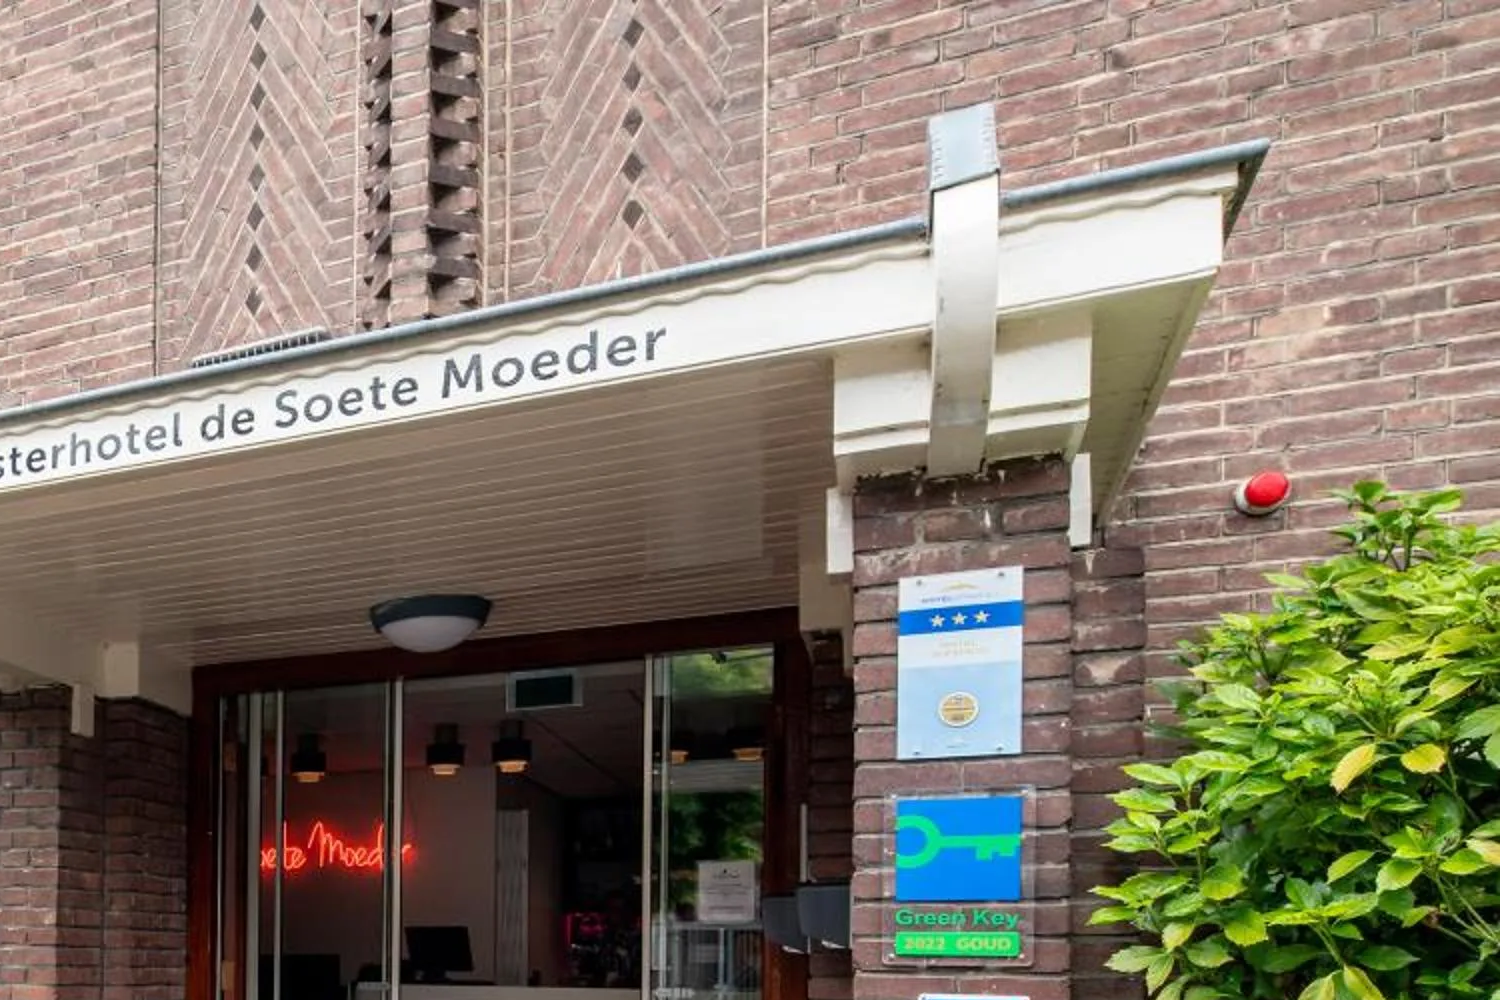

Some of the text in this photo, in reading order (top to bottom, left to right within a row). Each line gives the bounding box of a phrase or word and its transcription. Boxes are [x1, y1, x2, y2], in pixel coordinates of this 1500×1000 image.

[199, 403, 256, 441] de
[274, 370, 419, 429] Soete
[440, 326, 668, 399] Moeder
[308, 820, 412, 869] Moedr
[895, 909, 1019, 929] Green Key
[904, 936, 1012, 951] 2022 GOUD
